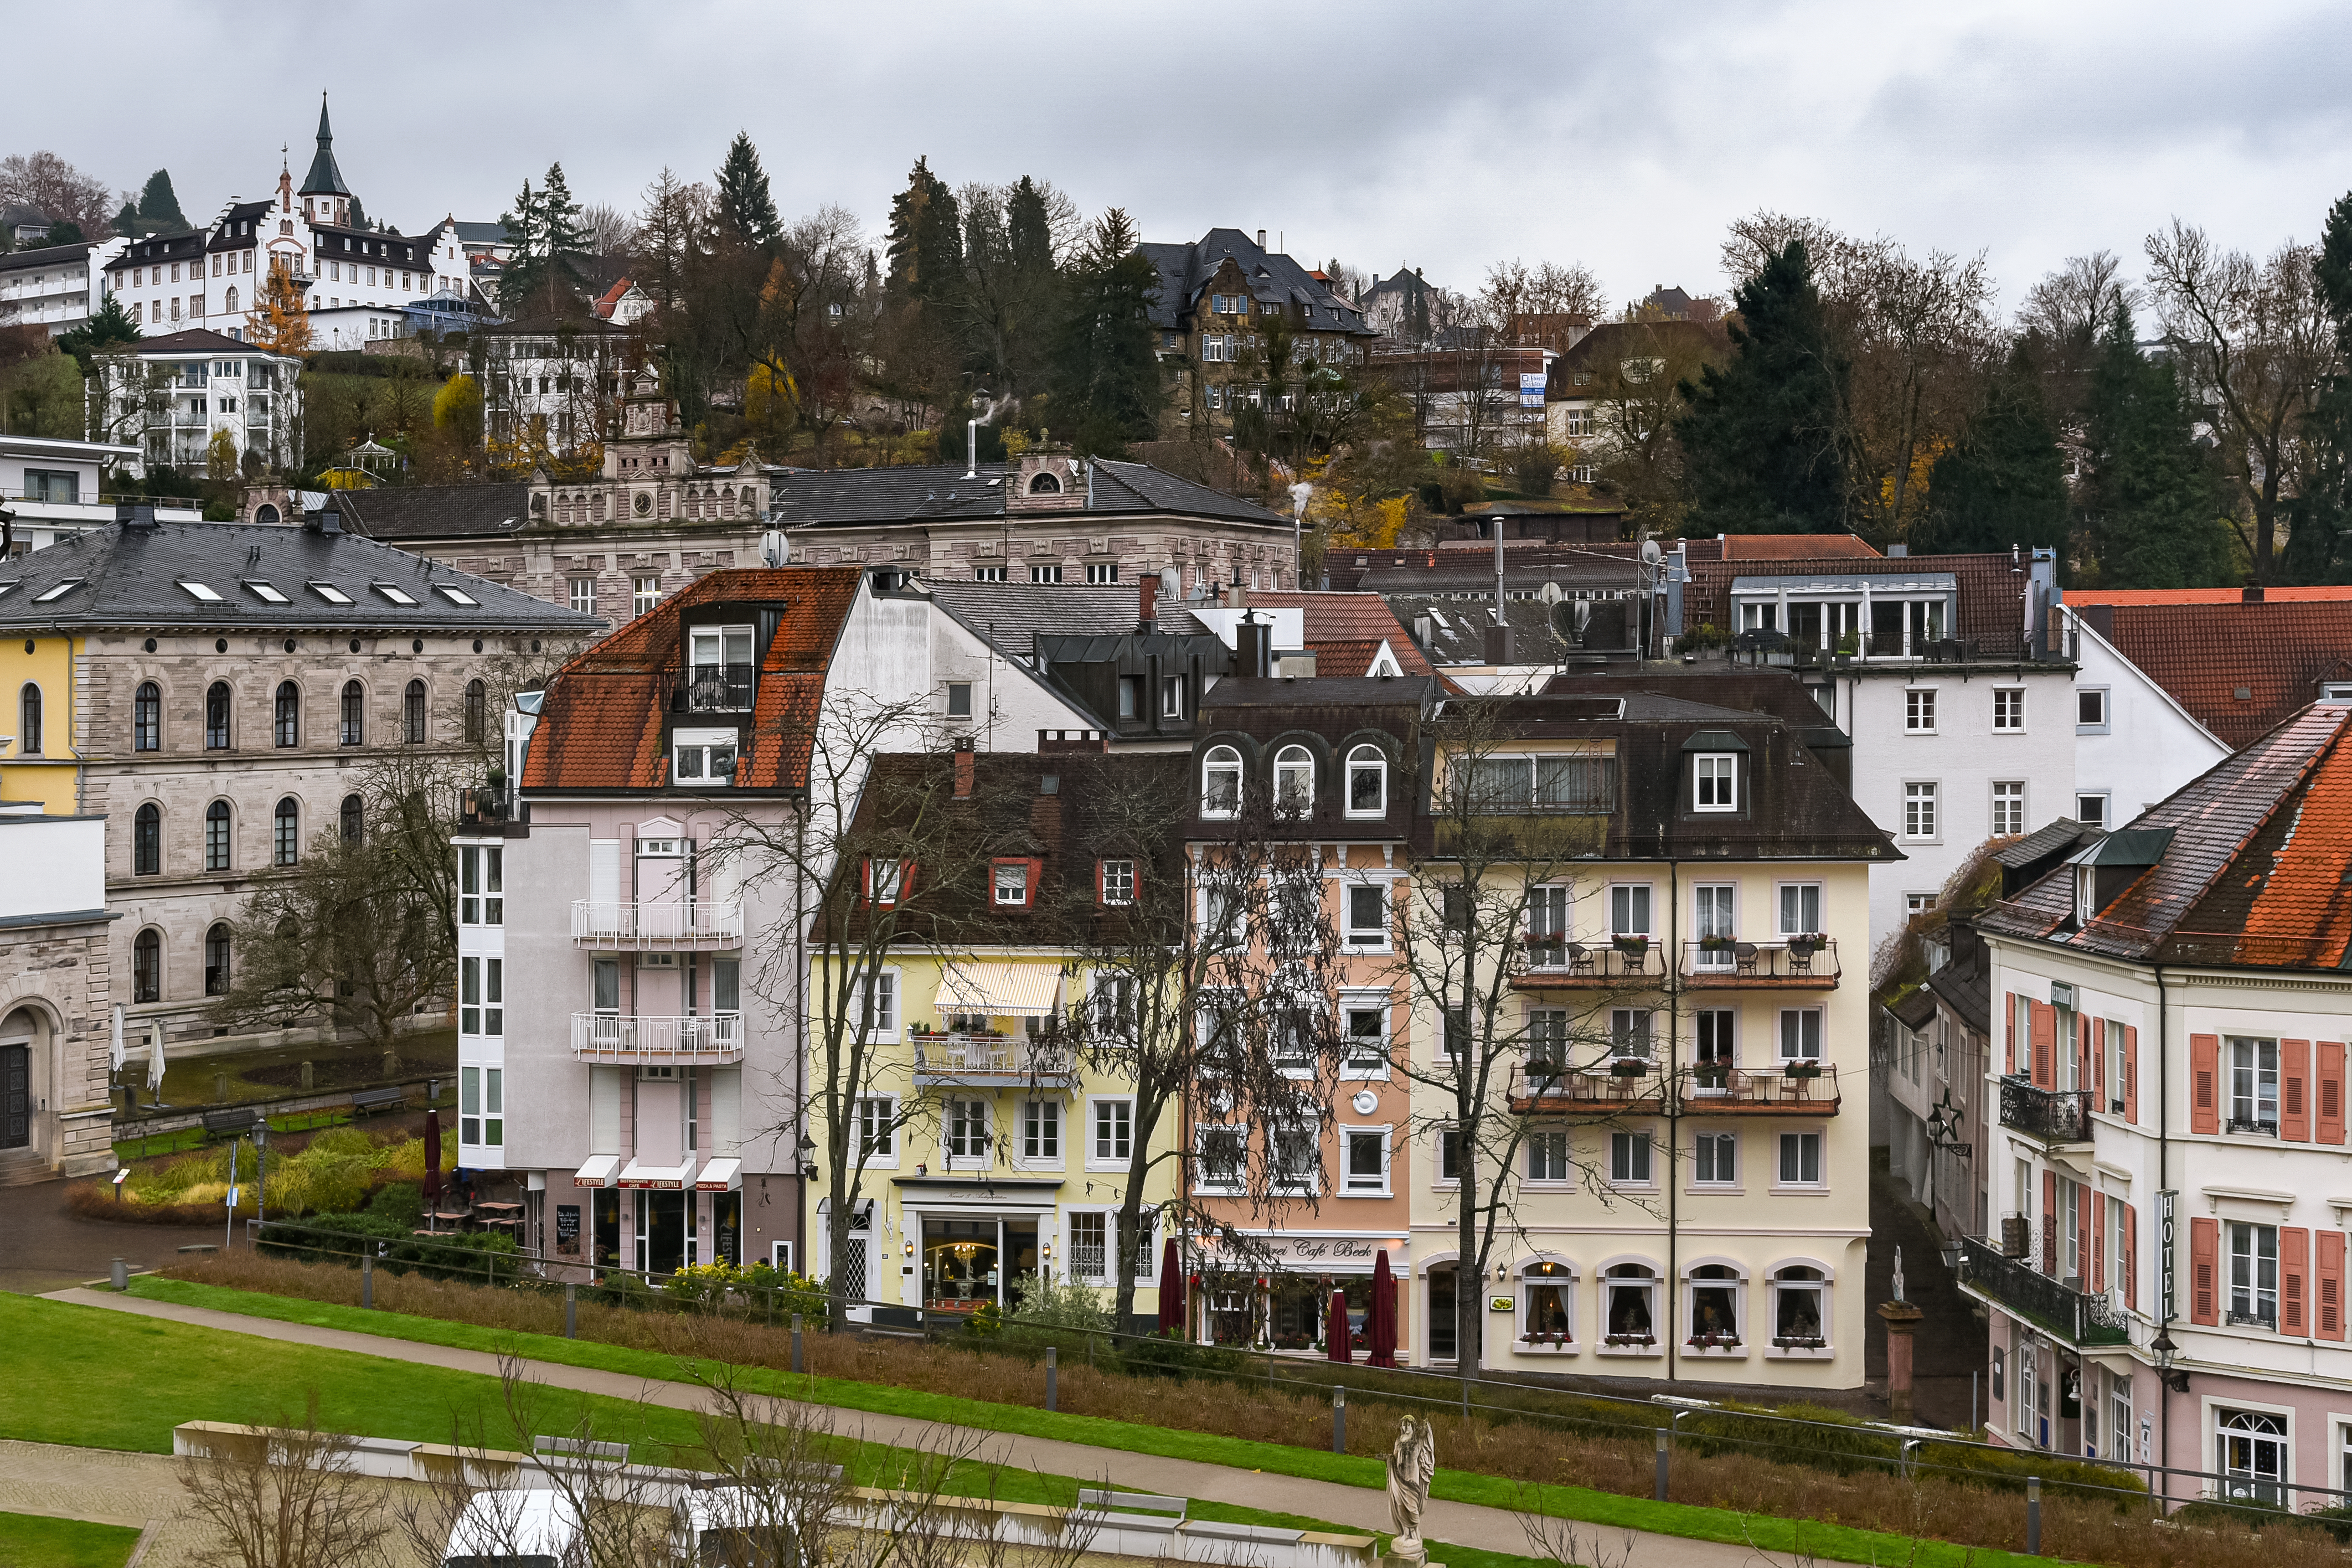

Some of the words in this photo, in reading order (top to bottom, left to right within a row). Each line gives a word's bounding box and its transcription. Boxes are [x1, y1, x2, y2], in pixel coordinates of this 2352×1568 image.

[649, 1179, 679, 1188] LIFESTYLE
[1293, 1239, 1329, 1261] Café
[1333, 1240, 1372, 1257] Beek
[2163, 1195, 2173, 1319] HOTEL
